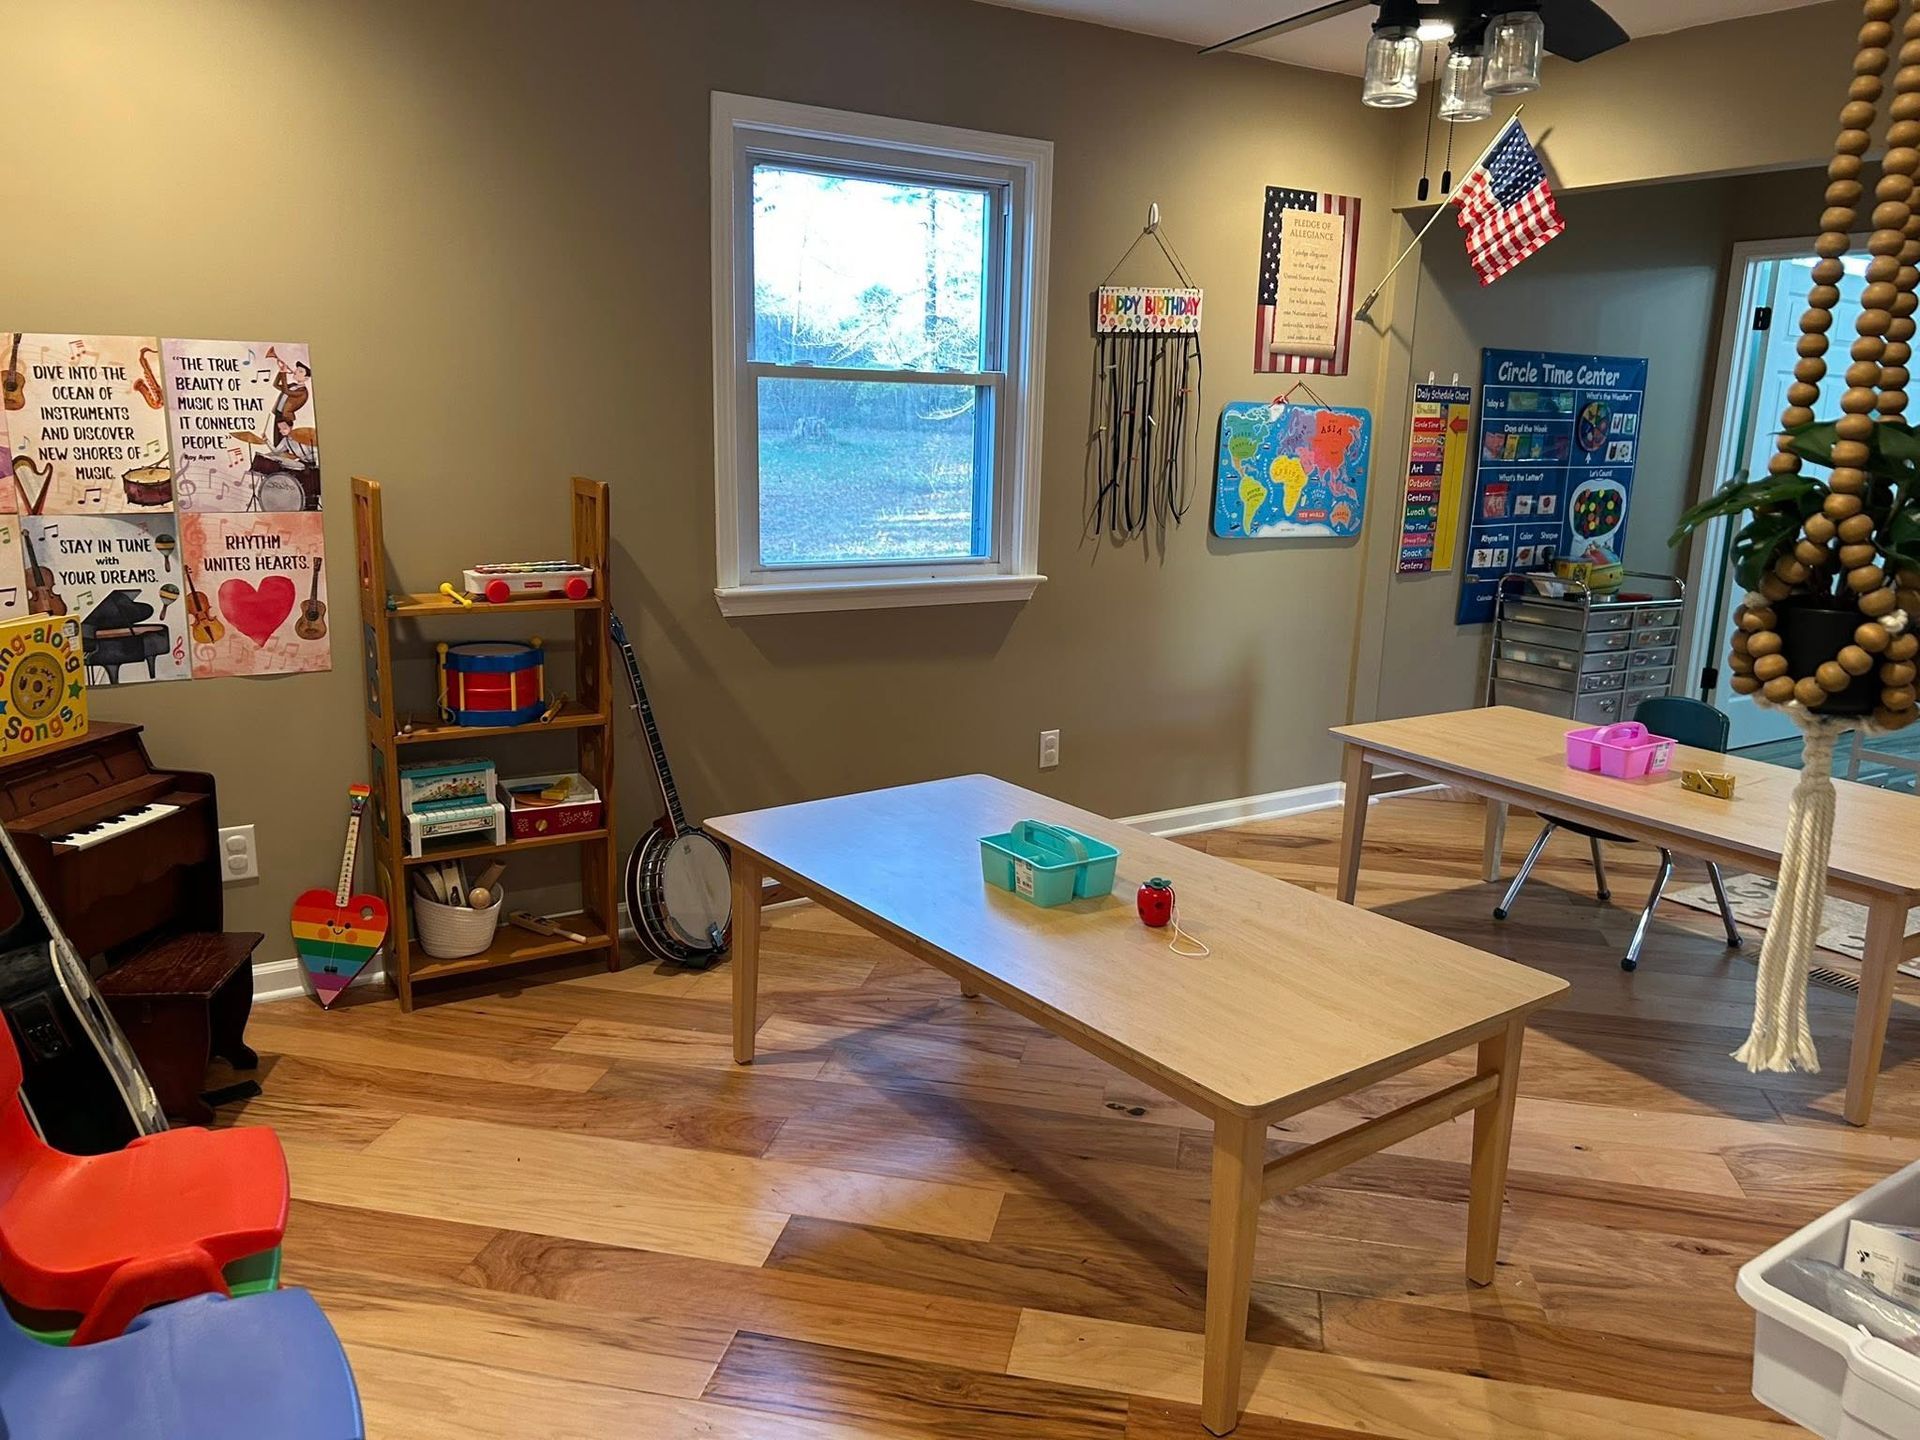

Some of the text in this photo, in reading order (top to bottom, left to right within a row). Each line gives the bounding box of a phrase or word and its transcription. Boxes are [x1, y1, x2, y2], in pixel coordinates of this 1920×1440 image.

[1294, 219, 1332, 230] PLEDGE OF
[1290, 230, 1334, 240] ALLEGIANCE
[1100, 295, 1200, 316] HAPPY BIRTHDAY
[32, 364, 126, 380] DIVE INTO THE
[208, 358, 240, 372] TRUE
[1498, 361, 1620, 386] Circle Time Center
[175, 377, 241, 392] BEAUTY OF
[52, 386, 113, 400] OCEAN OF
[1416, 388, 1470, 400] Daily Schedule Chart
[178, 396, 264, 411] MUSIC IS THAT
[40, 407, 130, 420] INSTRUMENTS
[180, 416, 256, 430] IT CONNECTS
[41, 426, 134, 441] AND DISCOVER
[1321, 426, 1342, 436] ASIA
[1413, 436, 1436, 444] Library
[38, 446, 141, 461] NEW SHORES OF
[76, 466, 116, 480] MUSIC.
[1410, 464, 1424, 474] Art
[1408, 478, 1432, 488] Outside
[1407, 494, 1431, 502] Centers
[1406, 507, 1426, 516] Lunch
[226, 534, 280, 550] RHYTHM
[1520, 532, 1534, 540] Color
[60, 538, 152, 554] STAY IN TUNE
[1402, 549, 1423, 558] Snack
[96, 556, 119, 566] with
[204, 554, 310, 572] UNITES HEARTS.
[1400, 562, 1424, 570] Centers
[58, 568, 158, 586] YOUR DREAMS.
[4, 706, 74, 743] Songs
